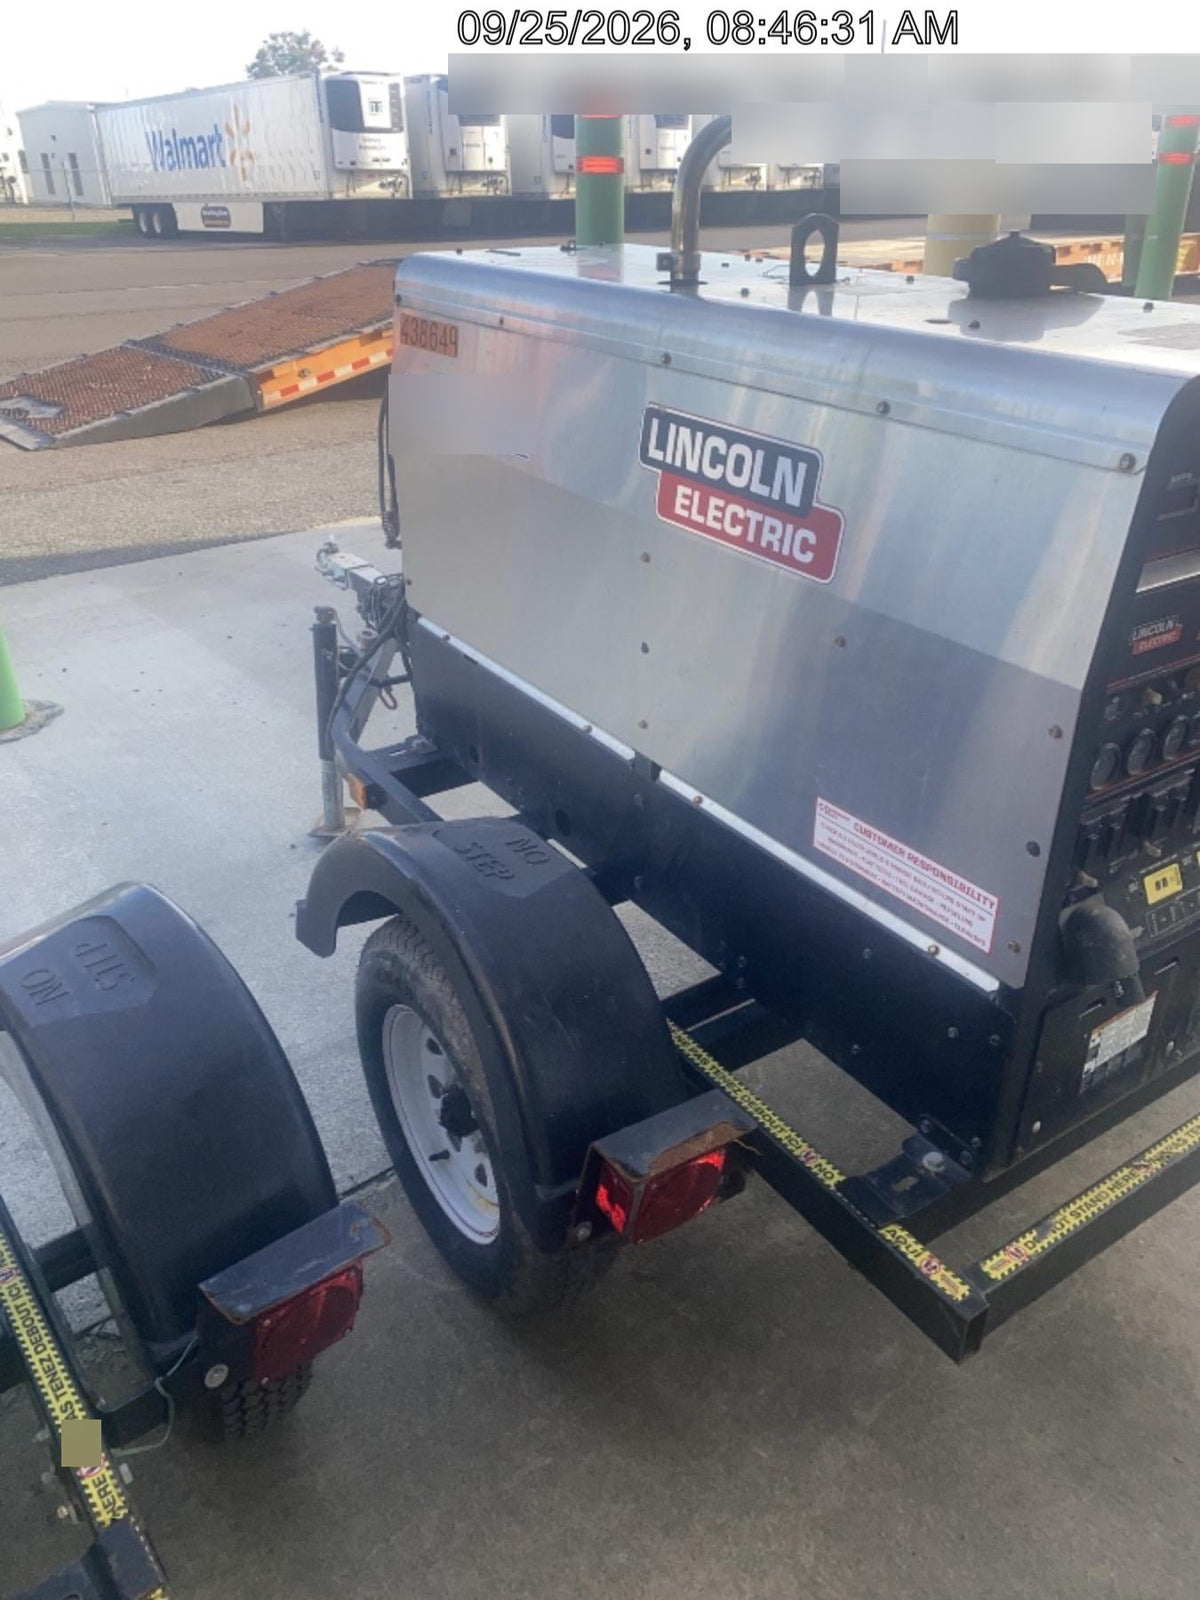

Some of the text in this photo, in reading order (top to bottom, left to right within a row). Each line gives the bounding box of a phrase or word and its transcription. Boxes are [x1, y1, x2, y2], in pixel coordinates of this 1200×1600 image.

[145, 124, 226, 172] Walmart
[400, 313, 458, 357] 438649
[648, 417, 807, 507] LINCOLN
[674, 484, 817, 563] ELECTRIC
[1132, 618, 1175, 641] LINCOLN
[453, 841, 516, 881] STEP
[504, 837, 551, 866] NO
[853, 821, 906, 858] CUSTOMER
[906, 852, 997, 910] RESPONSIBILITY
[20, 968, 70, 1006] NO
[740, 1092, 789, 1135] DEBOUT
[783, 1132, 803, 1150] ICI
[814, 1162, 835, 1181] NO
[1069, 1188, 1110, 1219] STAND
[1107, 1168, 1138, 1192] HERE
[6, 1282, 23, 1301] ICI
[13, 1301, 48, 1356] DEBOUT
[38, 1353, 68, 1402] TENEZ
